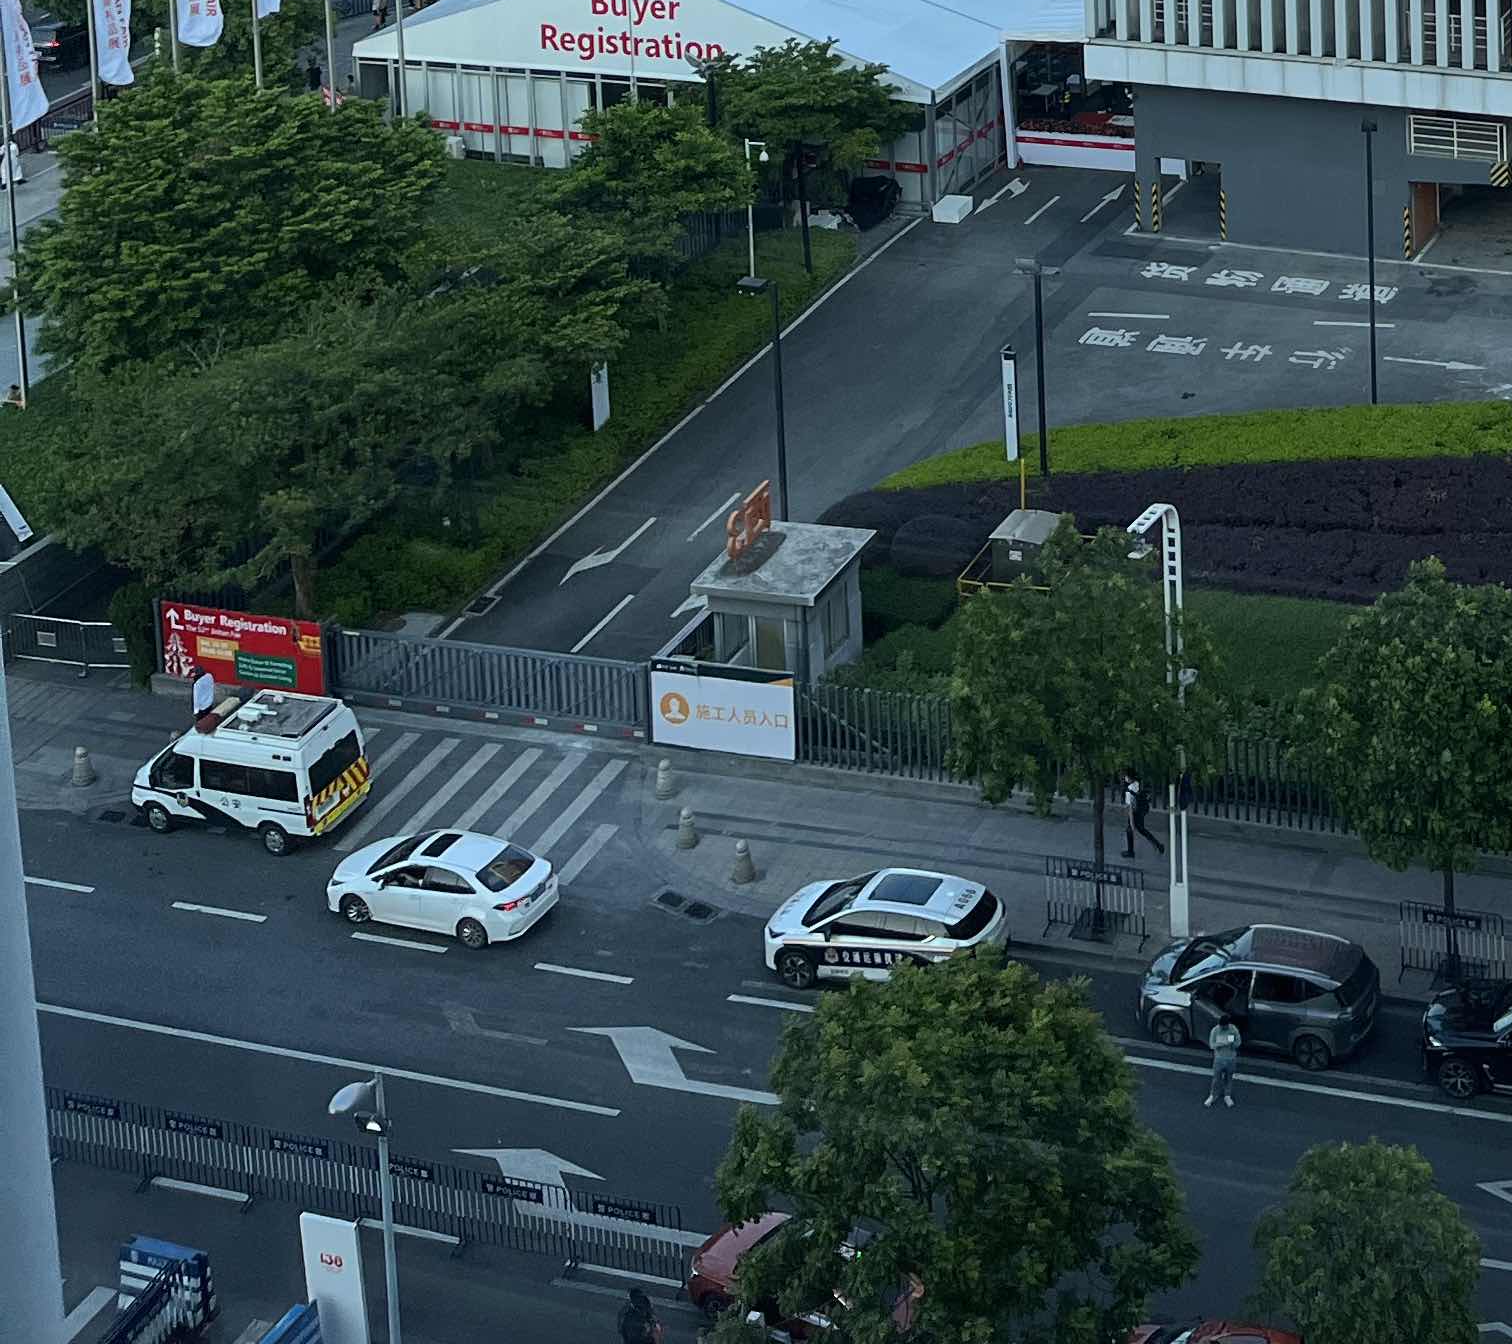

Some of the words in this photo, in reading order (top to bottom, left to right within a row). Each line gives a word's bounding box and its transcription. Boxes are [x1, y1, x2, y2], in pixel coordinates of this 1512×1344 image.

[540, 24, 724, 61] Registration
[1079, 326, 1352, 370] 行车通道
[184, 609, 217, 626] Buyer
[220, 615, 287, 635] Registration
[696, 704, 788, 728] 施工人员入口
[77, 1102, 106, 1116] POLICE
[178, 1122, 207, 1135] POLICE
[284, 1142, 313, 1154] POLICE
[608, 1206, 640, 1220] POLICE
